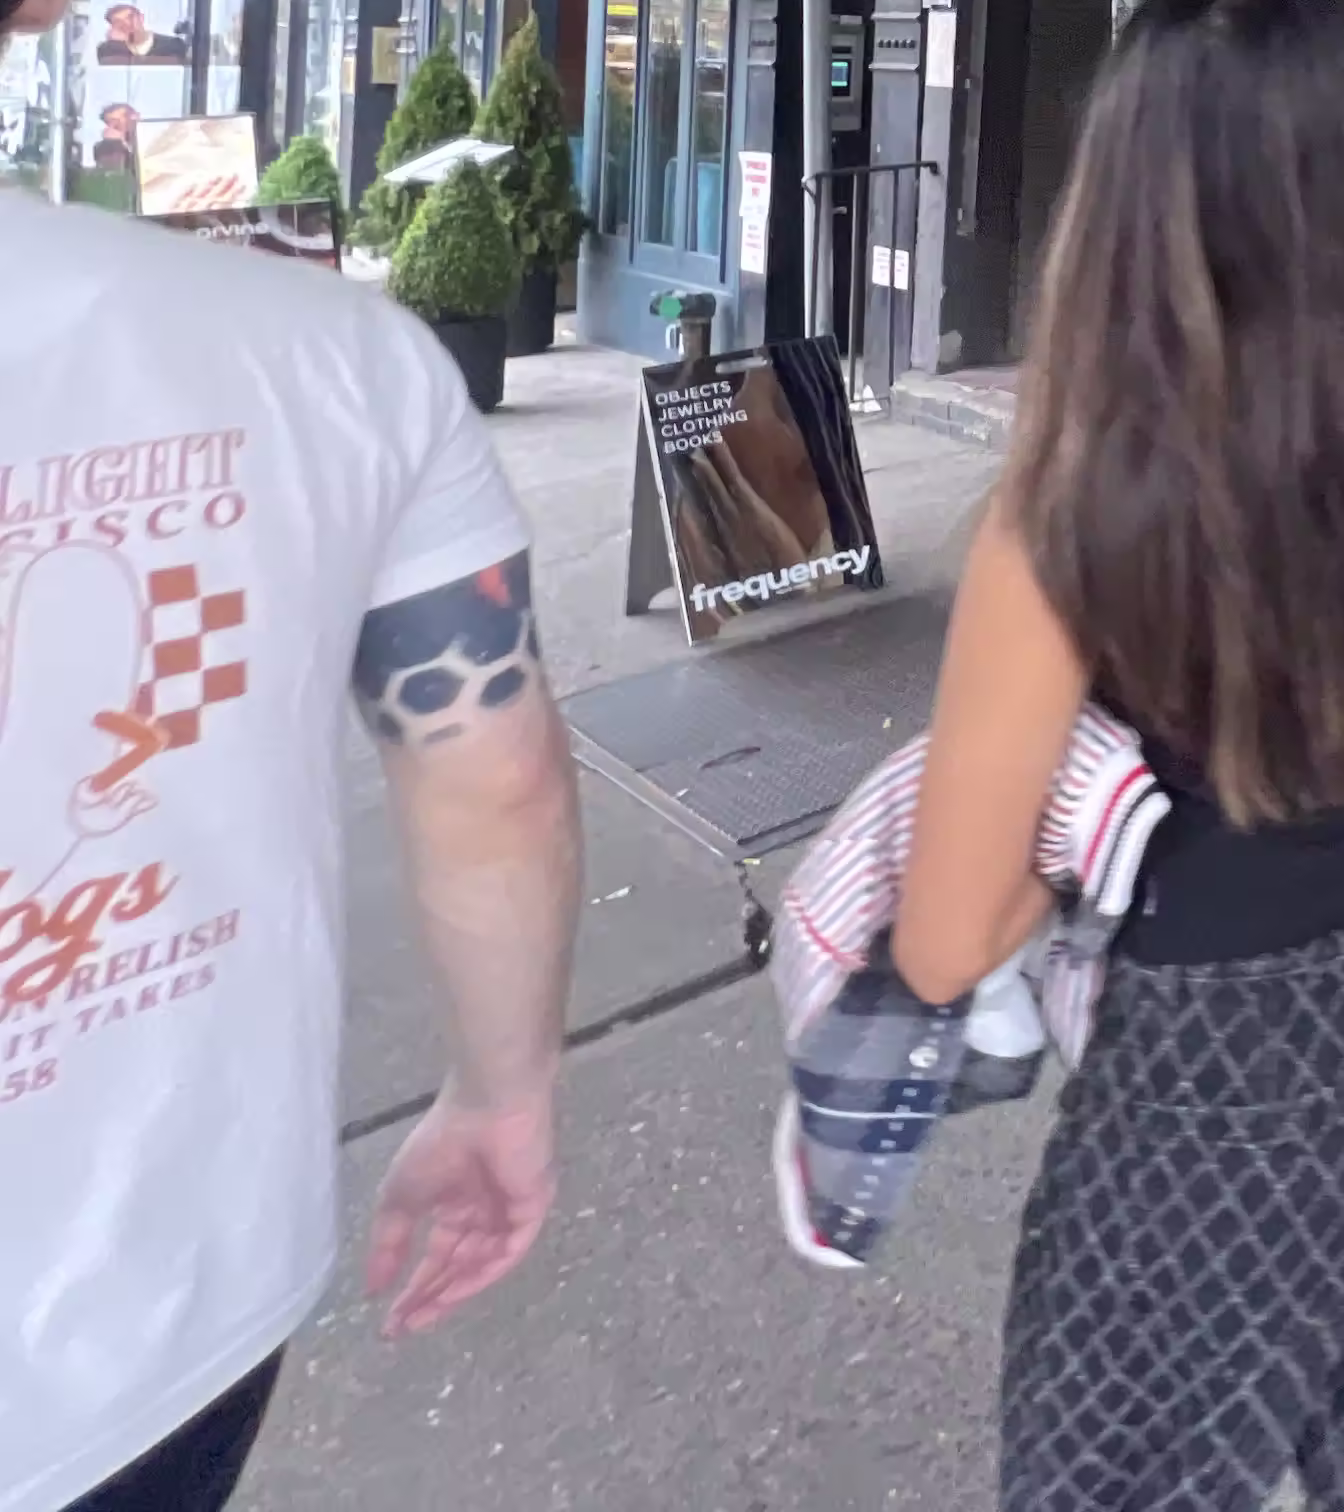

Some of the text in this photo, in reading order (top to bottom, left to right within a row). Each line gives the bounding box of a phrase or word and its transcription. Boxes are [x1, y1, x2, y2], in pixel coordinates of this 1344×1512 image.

[655, 380, 731, 406] OBJECTS
[658, 396, 734, 422] JEWELRY
[661, 409, 748, 438] CLOTHING
[664, 429, 725, 456] BOOKS
[690, 544, 871, 613] frequency
[0, 860, 181, 1025] ogs
[64, 908, 241, 1003] RELISH
[73, 962, 216, 1036] TAKES
